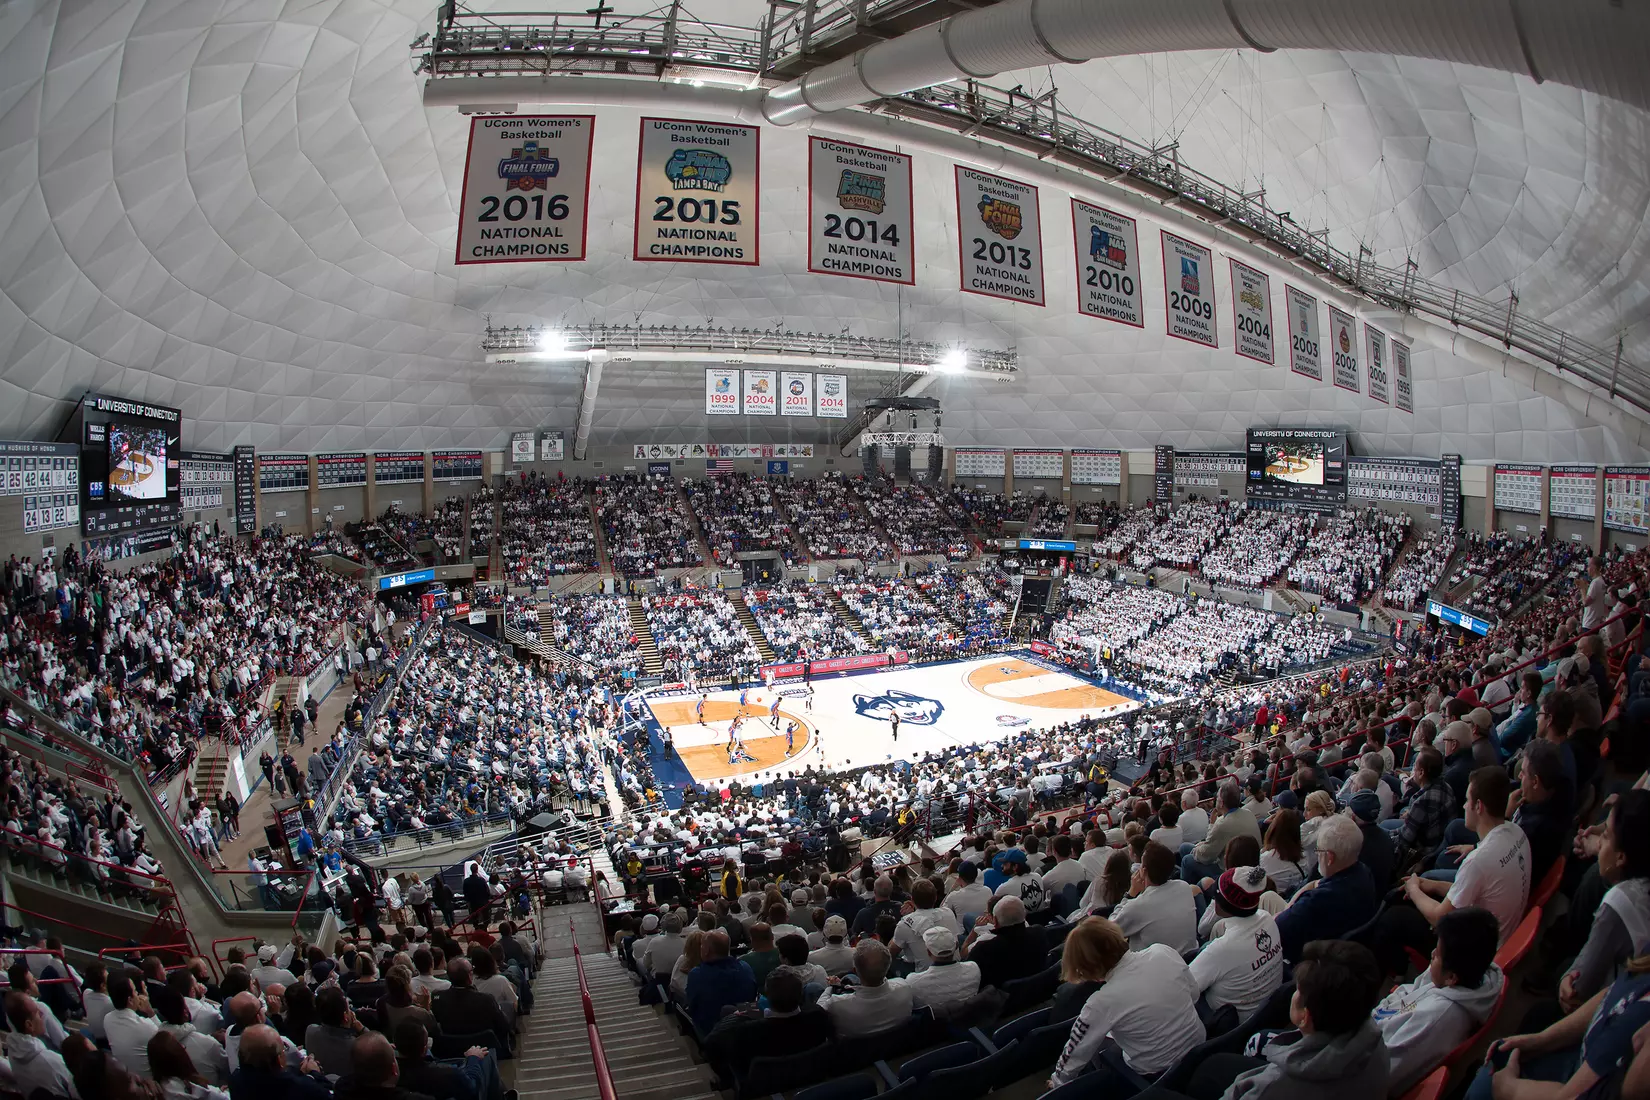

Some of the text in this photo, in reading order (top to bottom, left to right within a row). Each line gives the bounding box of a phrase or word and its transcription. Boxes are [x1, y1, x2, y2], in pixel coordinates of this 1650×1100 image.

[484, 119, 581, 128] UConn Women's
[654, 121, 748, 137] UConn Women's
[500, 130, 562, 139] Basketball
[671, 133, 730, 146] Basketball
[820, 141, 902, 164] UConn Women's
[503, 163, 554, 173] FINAL FOUR
[836, 155, 887, 172] Basketball
[674, 178, 701, 190] TAMPA
[853, 174, 882, 189] FINAL
[964, 170, 1030, 194] UConn Women's
[978, 183, 1019, 200] Basketball
[477, 194, 570, 222] 2016
[843, 196, 881, 208] NASHVILLE
[994, 200, 1019, 214] FINAL
[652, 196, 741, 226] 2015
[983, 205, 1020, 227] FOUR
[1078, 203, 1131, 227] UConn Women's
[823, 214, 900, 247] 2014
[1089, 216, 1122, 232] Basketball
[480, 226, 564, 240] NATIONAL
[657, 227, 738, 242] NATIONAL
[472, 243, 570, 257] CHAMPIONS
[649, 243, 744, 259] CHAMPIONS
[828, 243, 897, 263] NATIONAL
[972, 237, 1032, 270] 2013
[1166, 235, 1207, 256] UConn Women's
[1175, 246, 1200, 261] Basketball
[821, 258, 903, 278] CHAMPIONS
[976, 264, 1031, 285] NATIONAL
[972, 278, 1036, 299] CHAMPIONS
[1086, 265, 1134, 296] 2010
[1090, 290, 1133, 309] NATIONAL
[1170, 290, 1212, 320] 2009
[1087, 303, 1137, 323] CHAMPIONS
[1175, 314, 1210, 331] NATIONAL
[1237, 313, 1270, 340] 2004
[1173, 325, 1213, 343] CHAMPIONS
[1241, 335, 1268, 350] NATIONAL
[1293, 335, 1318, 358] 2003
[1240, 344, 1271, 361] CHAMPIONS
[1296, 354, 1317, 367] NATIONAL
[1295, 363, 1319, 377] CHAMPIONS
[1335, 352, 1357, 372] 2002
[1337, 369, 1356, 380] NATIONAL
[1369, 365, 1387, 385] 2000
[1336, 378, 1358, 389] CHAMPIONS
[1396, 379, 1411, 395] 1995
[710, 394, 736, 404] 1999
[745, 395, 775, 404] 2004
[785, 396, 808, 405] 2011
[820, 397, 844, 407] 2014
[97, 398, 178, 421] UNIVERSITY OF CONNECTICUT
[89, 424, 105, 433] WELLS
[9, 471, 77, 488] 25 42 44 42
[90, 481, 103, 491] CBS
[1337, 492, 1345, 500] 29
[1349, 487, 1357, 495] 23
[1371, 489, 1379, 497] 30
[26, 508, 65, 526] 24 13 22
[87, 517, 96, 531] 29
[653, 857, 670, 866] 111
[1499, 845, 1518, 868] Hartford
[1251, 942, 1281, 971] UCONN
